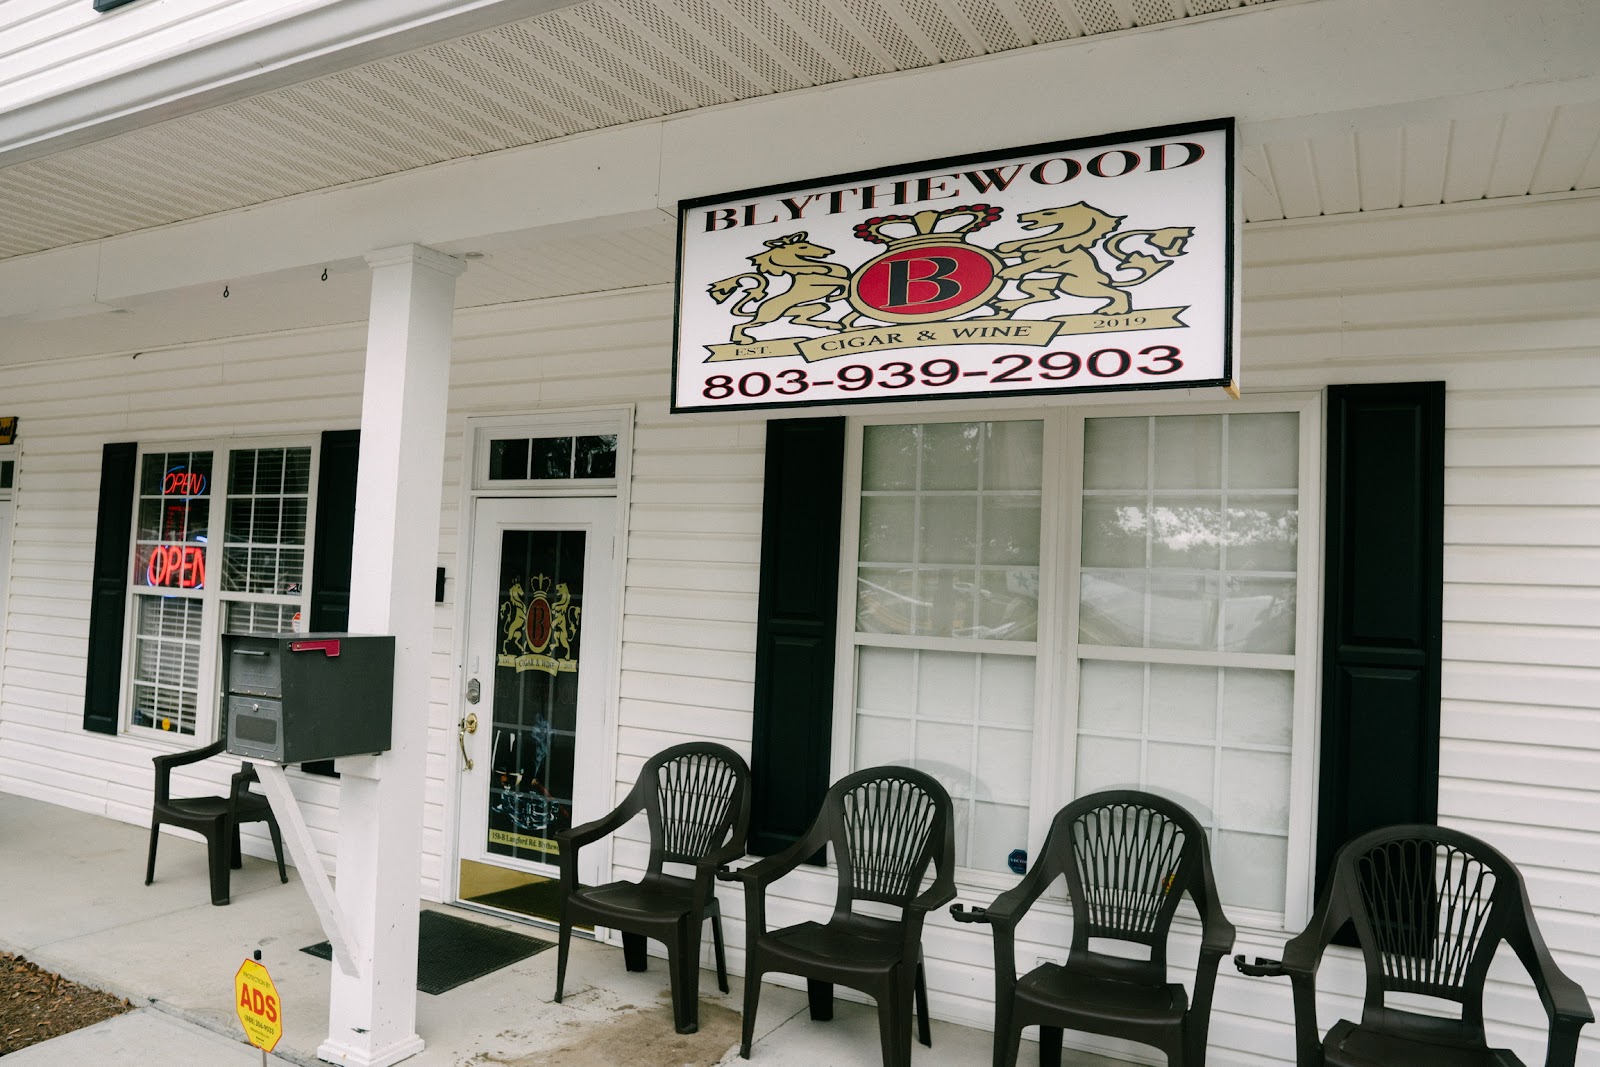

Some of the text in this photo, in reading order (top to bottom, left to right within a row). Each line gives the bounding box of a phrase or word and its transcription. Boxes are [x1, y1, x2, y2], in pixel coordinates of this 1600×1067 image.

[702, 142, 1205, 233] BLYTHEWOOD
[881, 256, 962, 309] B
[821, 325, 1032, 352] CIGAR & WINE
[1093, 316, 1147, 329] 2019
[735, 345, 772, 357] EST.
[702, 344, 1184, 400] 803-939-2903
[163, 472, 203, 494] OPEN
[149, 545, 205, 587] OPEN
[242, 971, 266, 987] PROTECTION
[240, 983, 277, 1023] ADS
